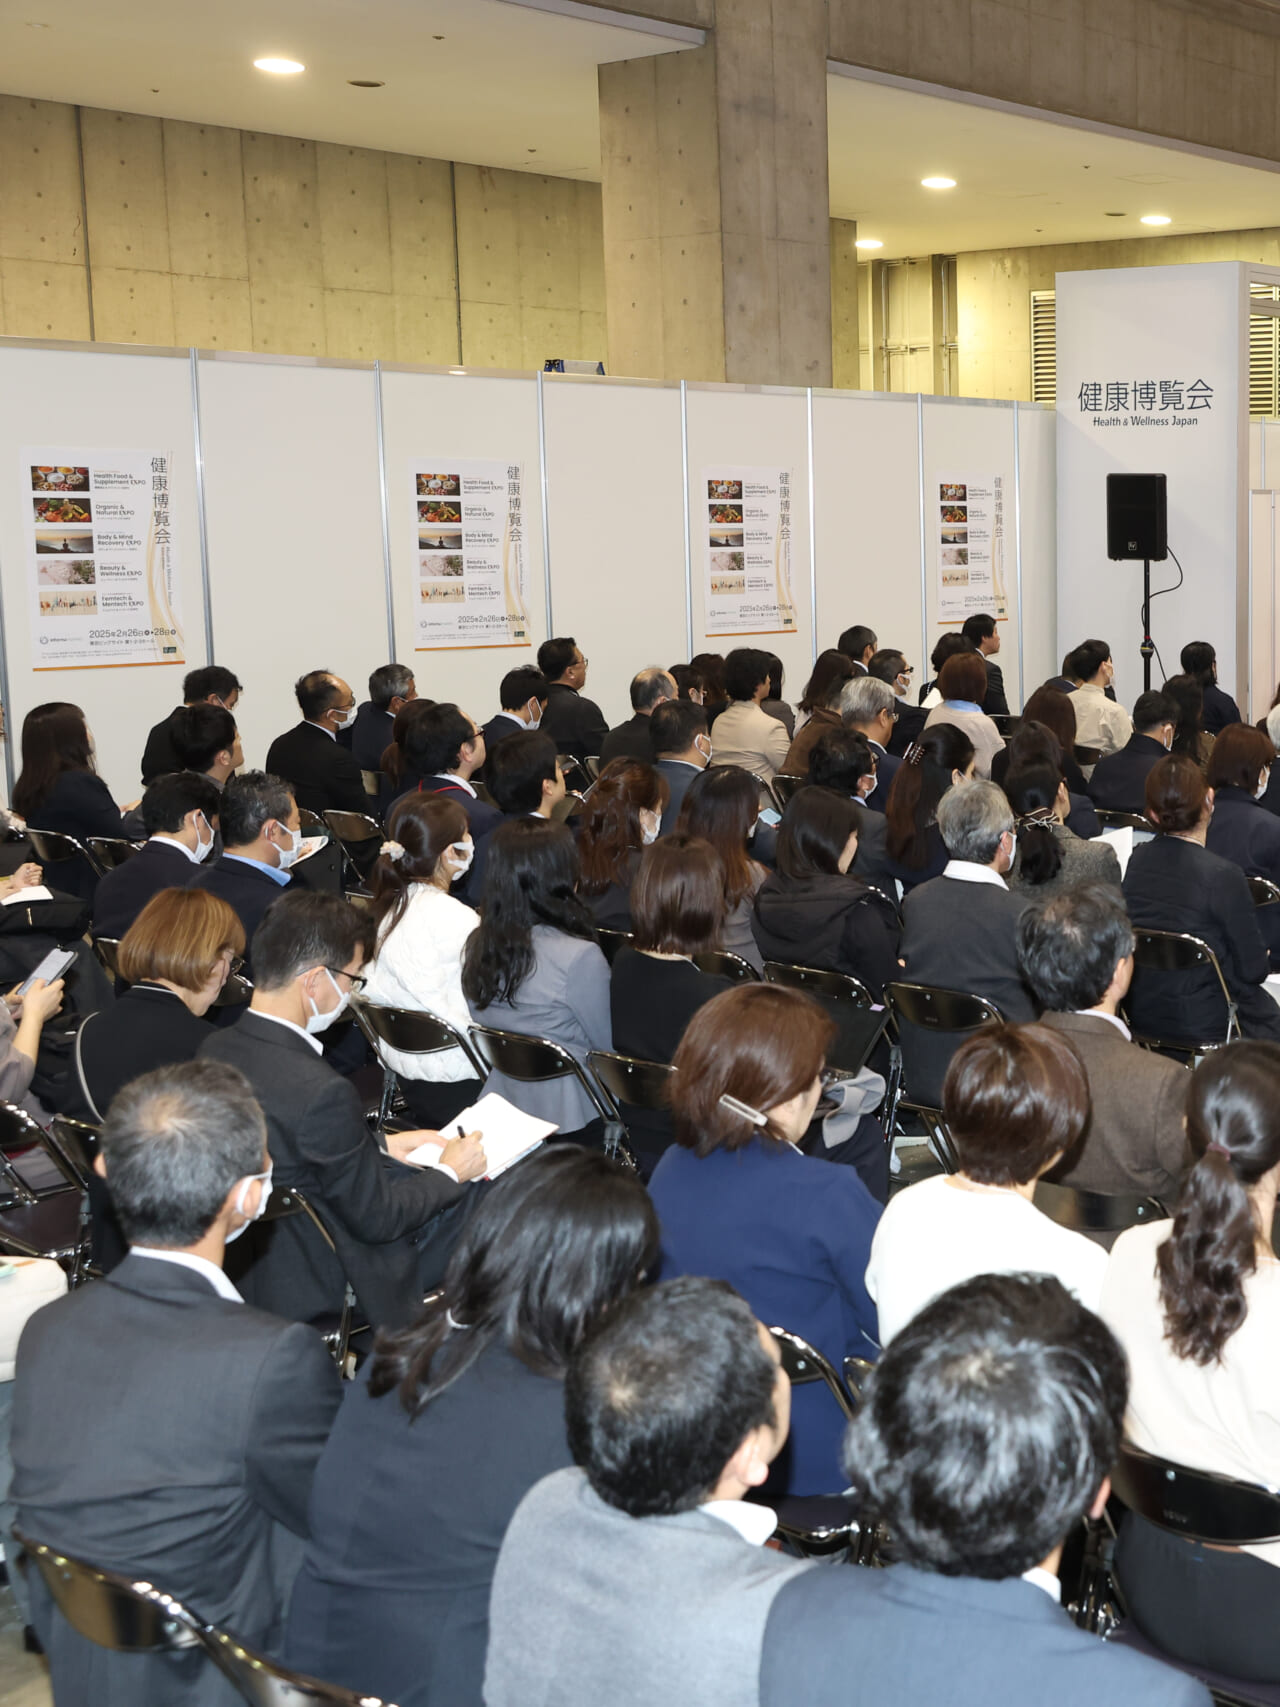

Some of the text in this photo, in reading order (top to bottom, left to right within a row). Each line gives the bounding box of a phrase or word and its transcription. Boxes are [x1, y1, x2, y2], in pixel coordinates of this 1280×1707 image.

[1077, 379, 1214, 412] 健康博覧会
[1093, 415, 1198, 428] Health & Wellness Japan
[151, 457, 171, 545] 健康博覧会
[507, 465, 522, 542] 健康博覧会
